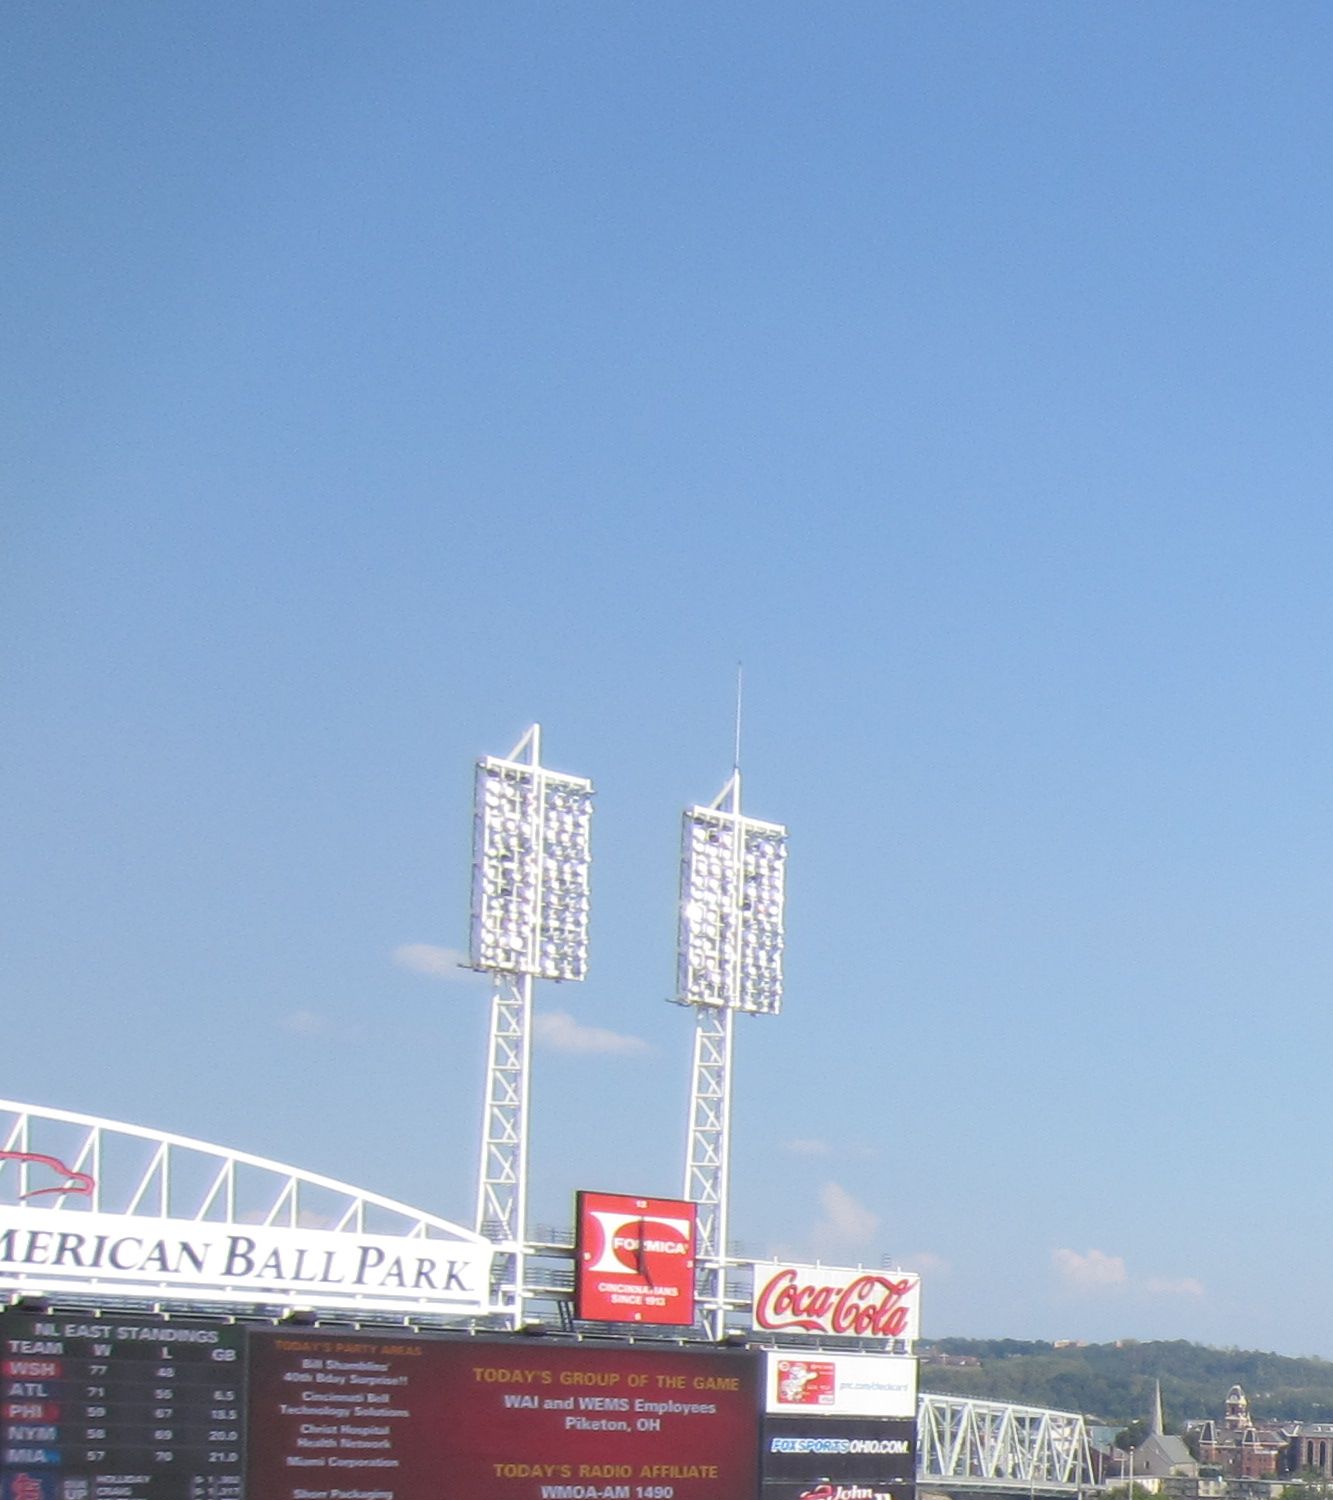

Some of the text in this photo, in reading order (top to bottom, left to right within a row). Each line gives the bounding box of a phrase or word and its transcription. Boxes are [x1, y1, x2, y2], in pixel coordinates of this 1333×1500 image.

[614, 1237, 687, 1254] FORMICA
[221, 1235, 346, 1283] BALL
[353, 1245, 475, 1292] PARK
[611, 1294, 642, 1305] SINCE
[756, 1268, 918, 1338] Coca-Cola
[35, 1323, 219, 1343] NL EAST STANDINGS
[9, 1340, 237, 1361] TEAM W L GB
[11, 1362, 55, 1376] WSH
[91, 1365, 108, 1376] 77
[315, 1373, 346, 1385] Bday
[474, 1367, 739, 1391] TODAY'S GROUP OF THE GAME
[9, 1383, 48, 1397] ATL
[10, 1404, 43, 1418] PHI
[504, 1395, 717, 1416] WAI and WEMS Employees
[565, 1416, 661, 1433] Piketon, OH
[8, 1426, 57, 1440] NYM
[7, 1449, 47, 1463] MIA
[328, 1457, 399, 1468] Corporation
[493, 1463, 718, 1479] TODAY'S RADIO AFFILIATE
[540, 1484, 674, 1500] WMOA-AM 1490
